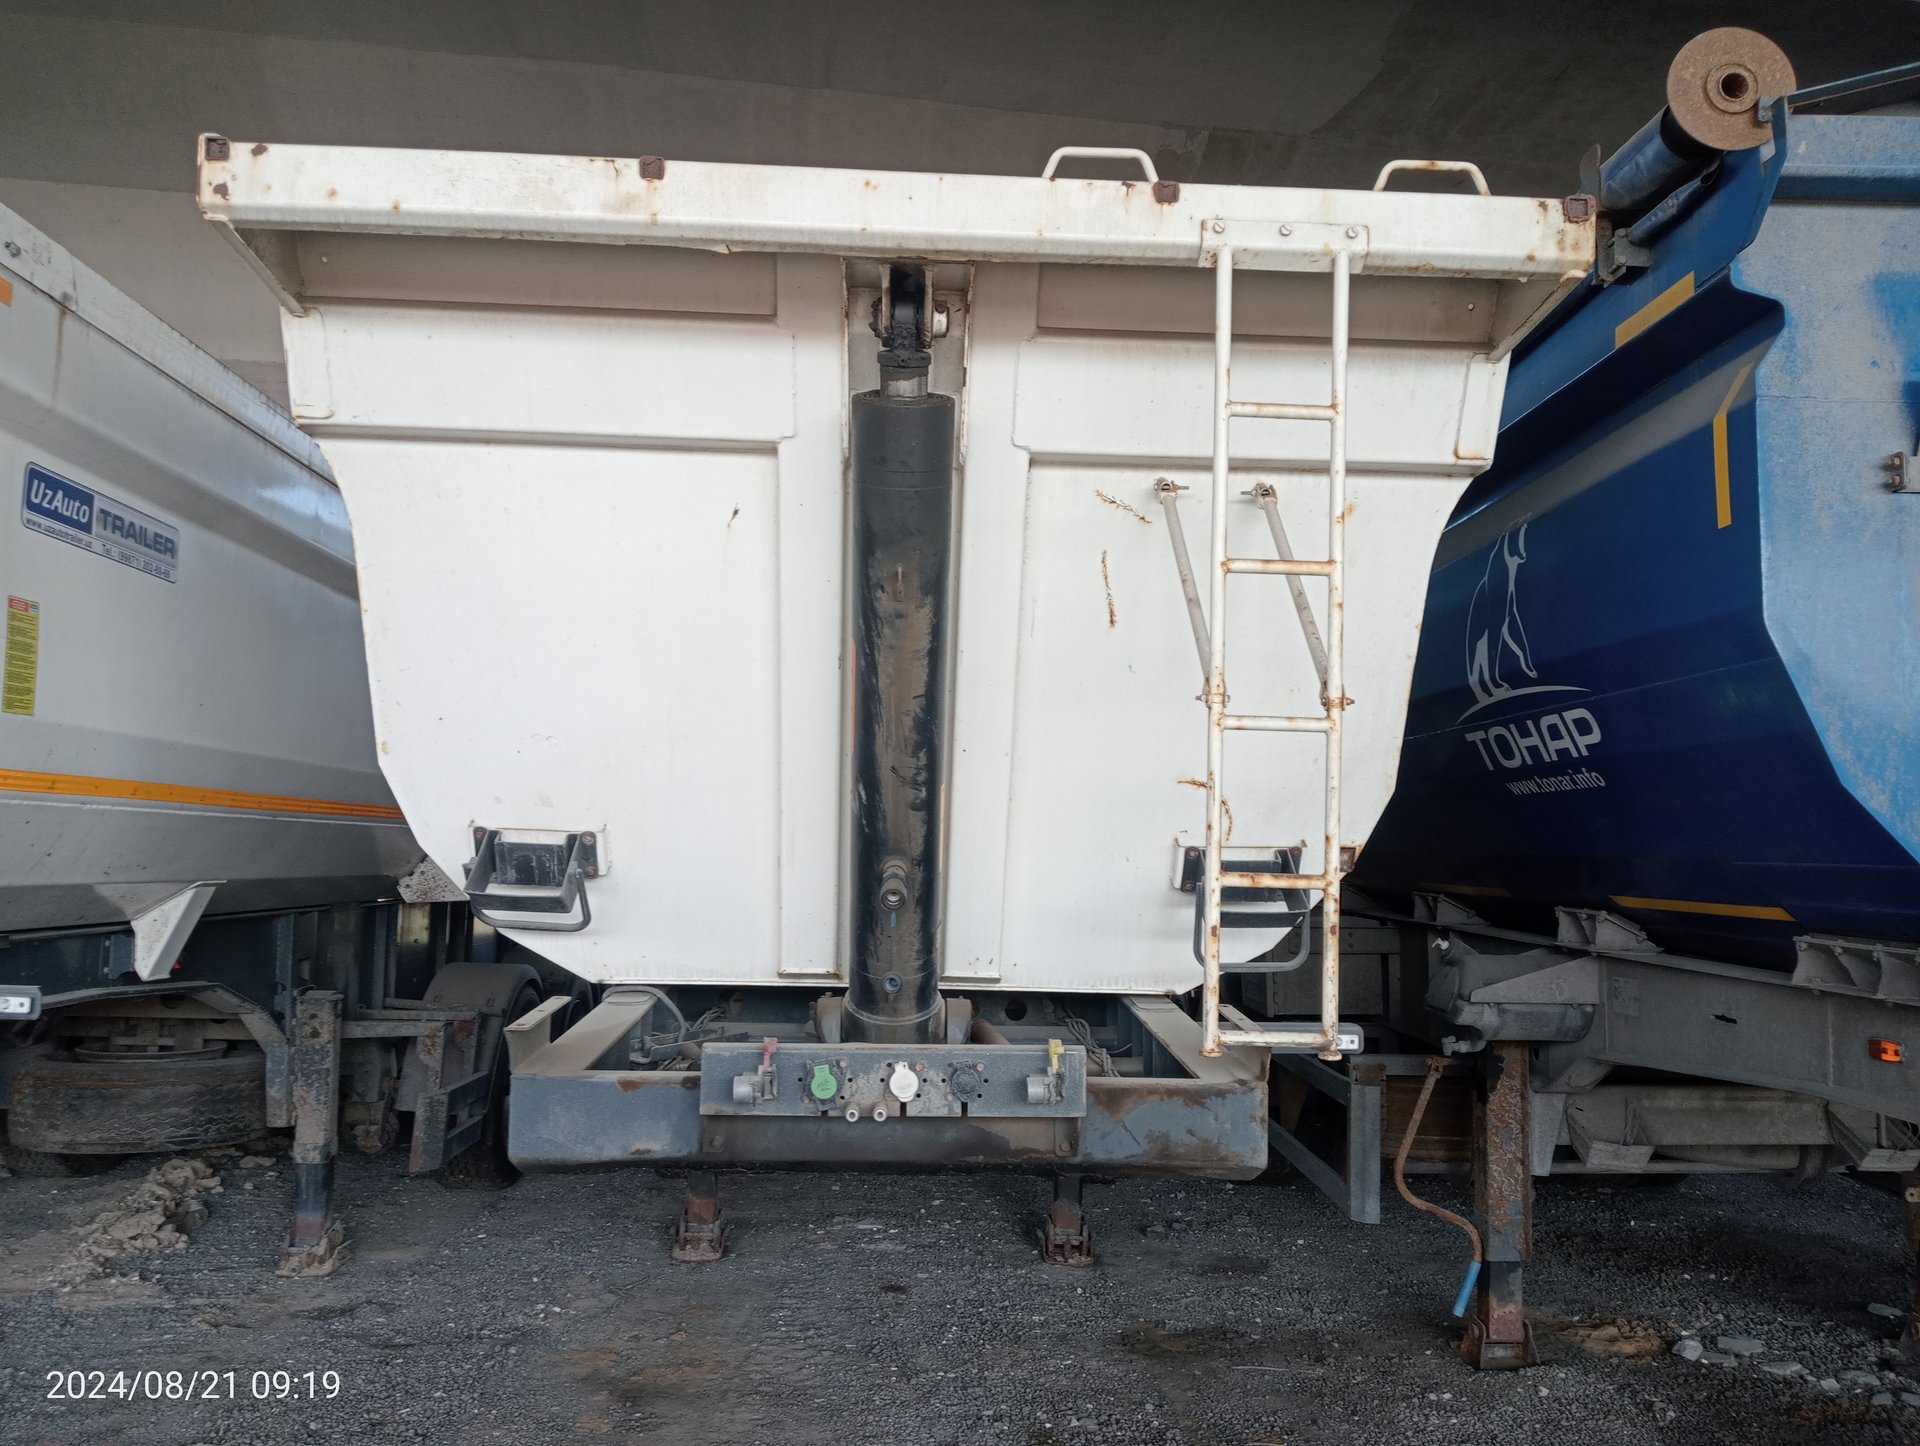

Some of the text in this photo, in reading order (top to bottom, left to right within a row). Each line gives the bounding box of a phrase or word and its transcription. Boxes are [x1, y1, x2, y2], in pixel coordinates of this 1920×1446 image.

[30, 479, 175, 559] UzAuto TRAILER
[1464, 708, 1602, 771] ТОНАР
[1505, 767, 1606, 796] www.tonar.info
